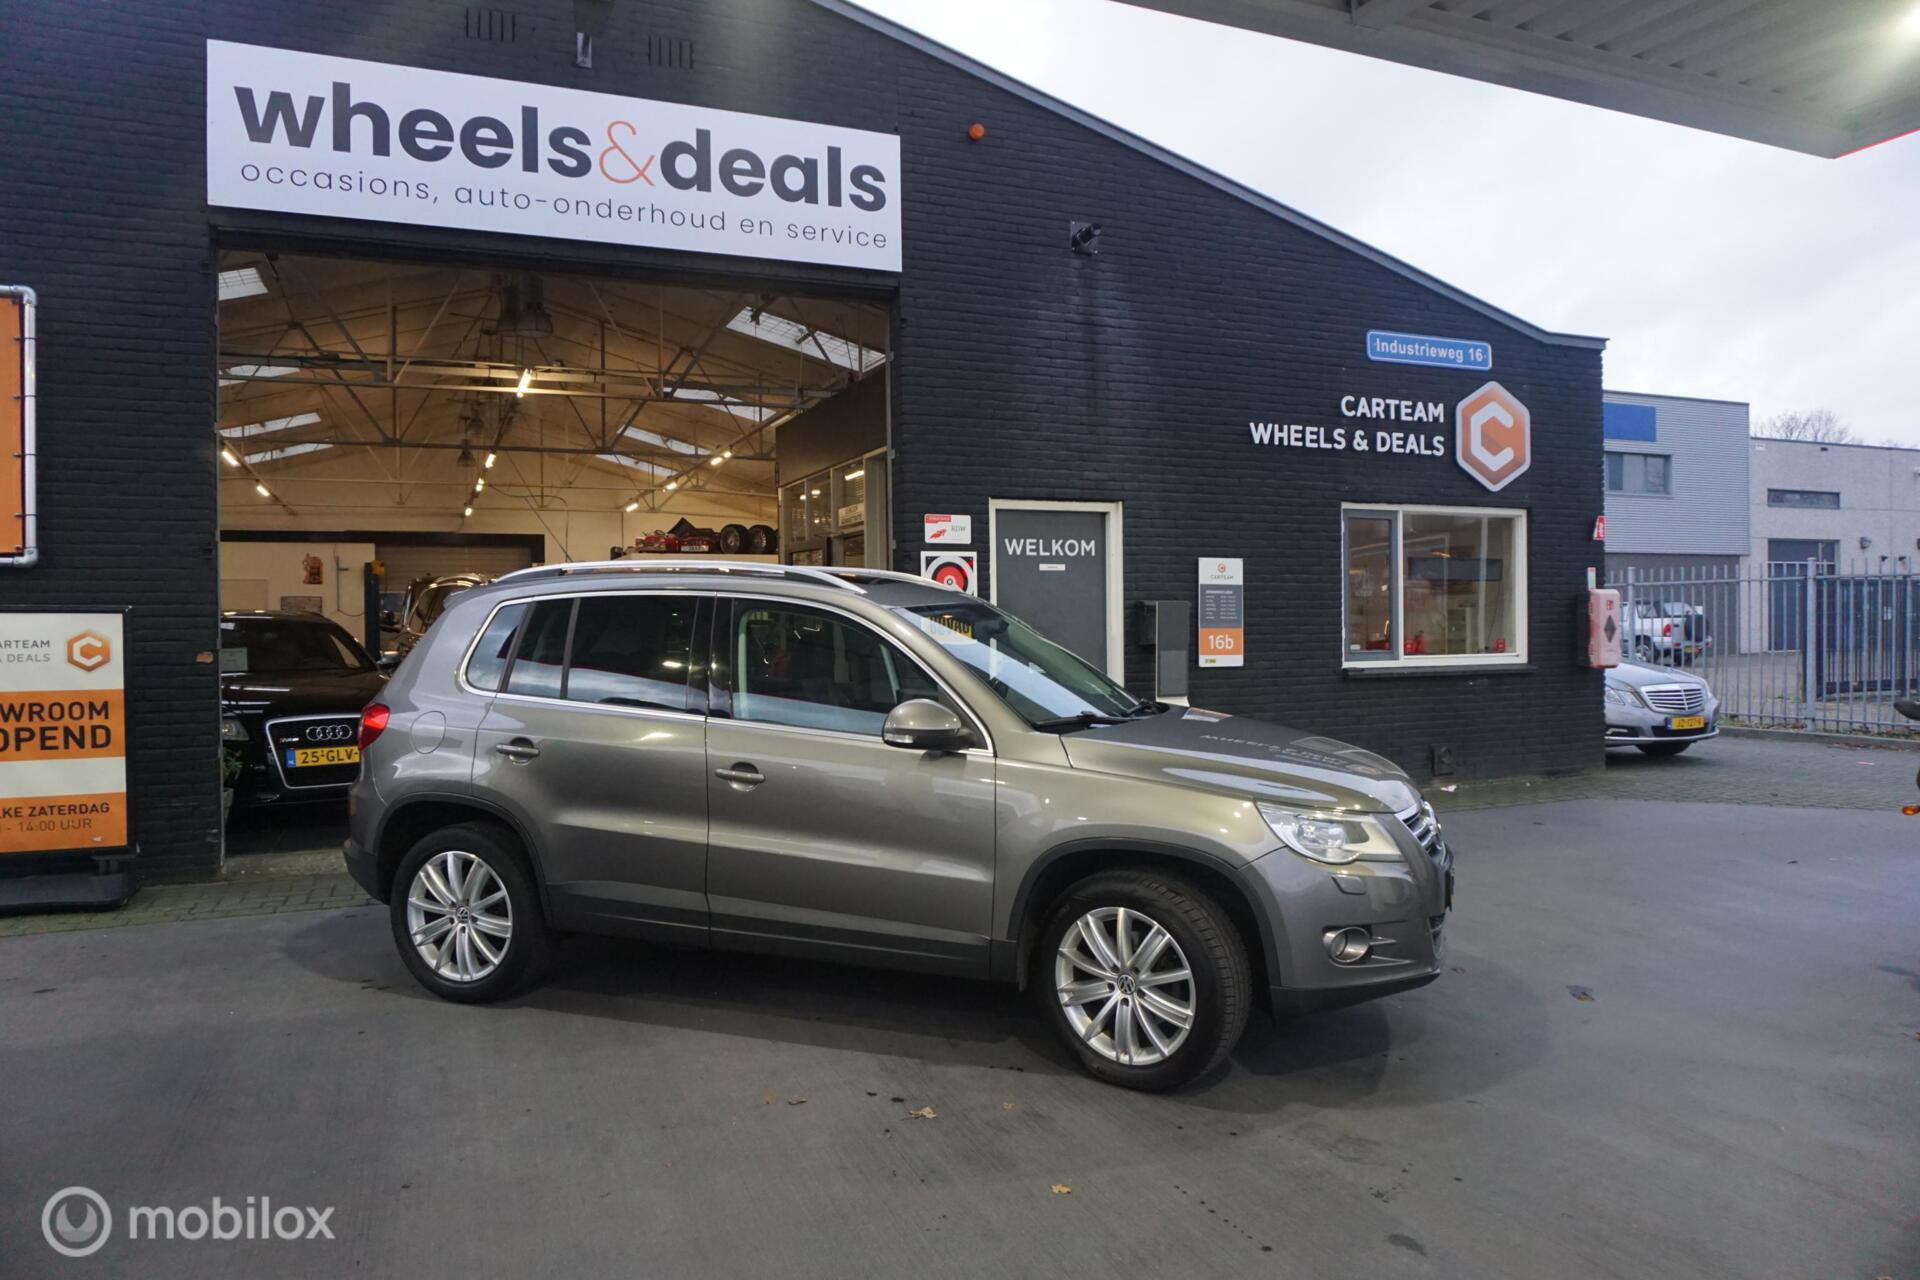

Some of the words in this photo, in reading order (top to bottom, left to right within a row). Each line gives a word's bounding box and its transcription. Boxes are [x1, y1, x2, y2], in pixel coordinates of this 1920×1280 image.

[241, 163, 440, 203] occasions,
[454, 186, 726, 233] auto-onderhoud
[740, 217, 774, 237] en
[787, 222, 888, 250] service
[1375, 338, 1464, 362] Industrieweg
[1468, 348, 1483, 362] 16
[1340, 395, 1445, 423] CARTEAM
[1249, 422, 1346, 450] WHEELS
[1352, 430, 1369, 451] &
[1376, 431, 1445, 457] DEALS
[1004, 538, 1096, 557] WELKOM
[1208, 634, 1234, 650] 16b
[7, 653, 51, 662] DEALS
[0, 807, 22, 818] KE
[28, 803, 110, 817] ZATERDAG
[19, 820, 56, 832] 14:00
[60, 818, 92, 830] UUR
